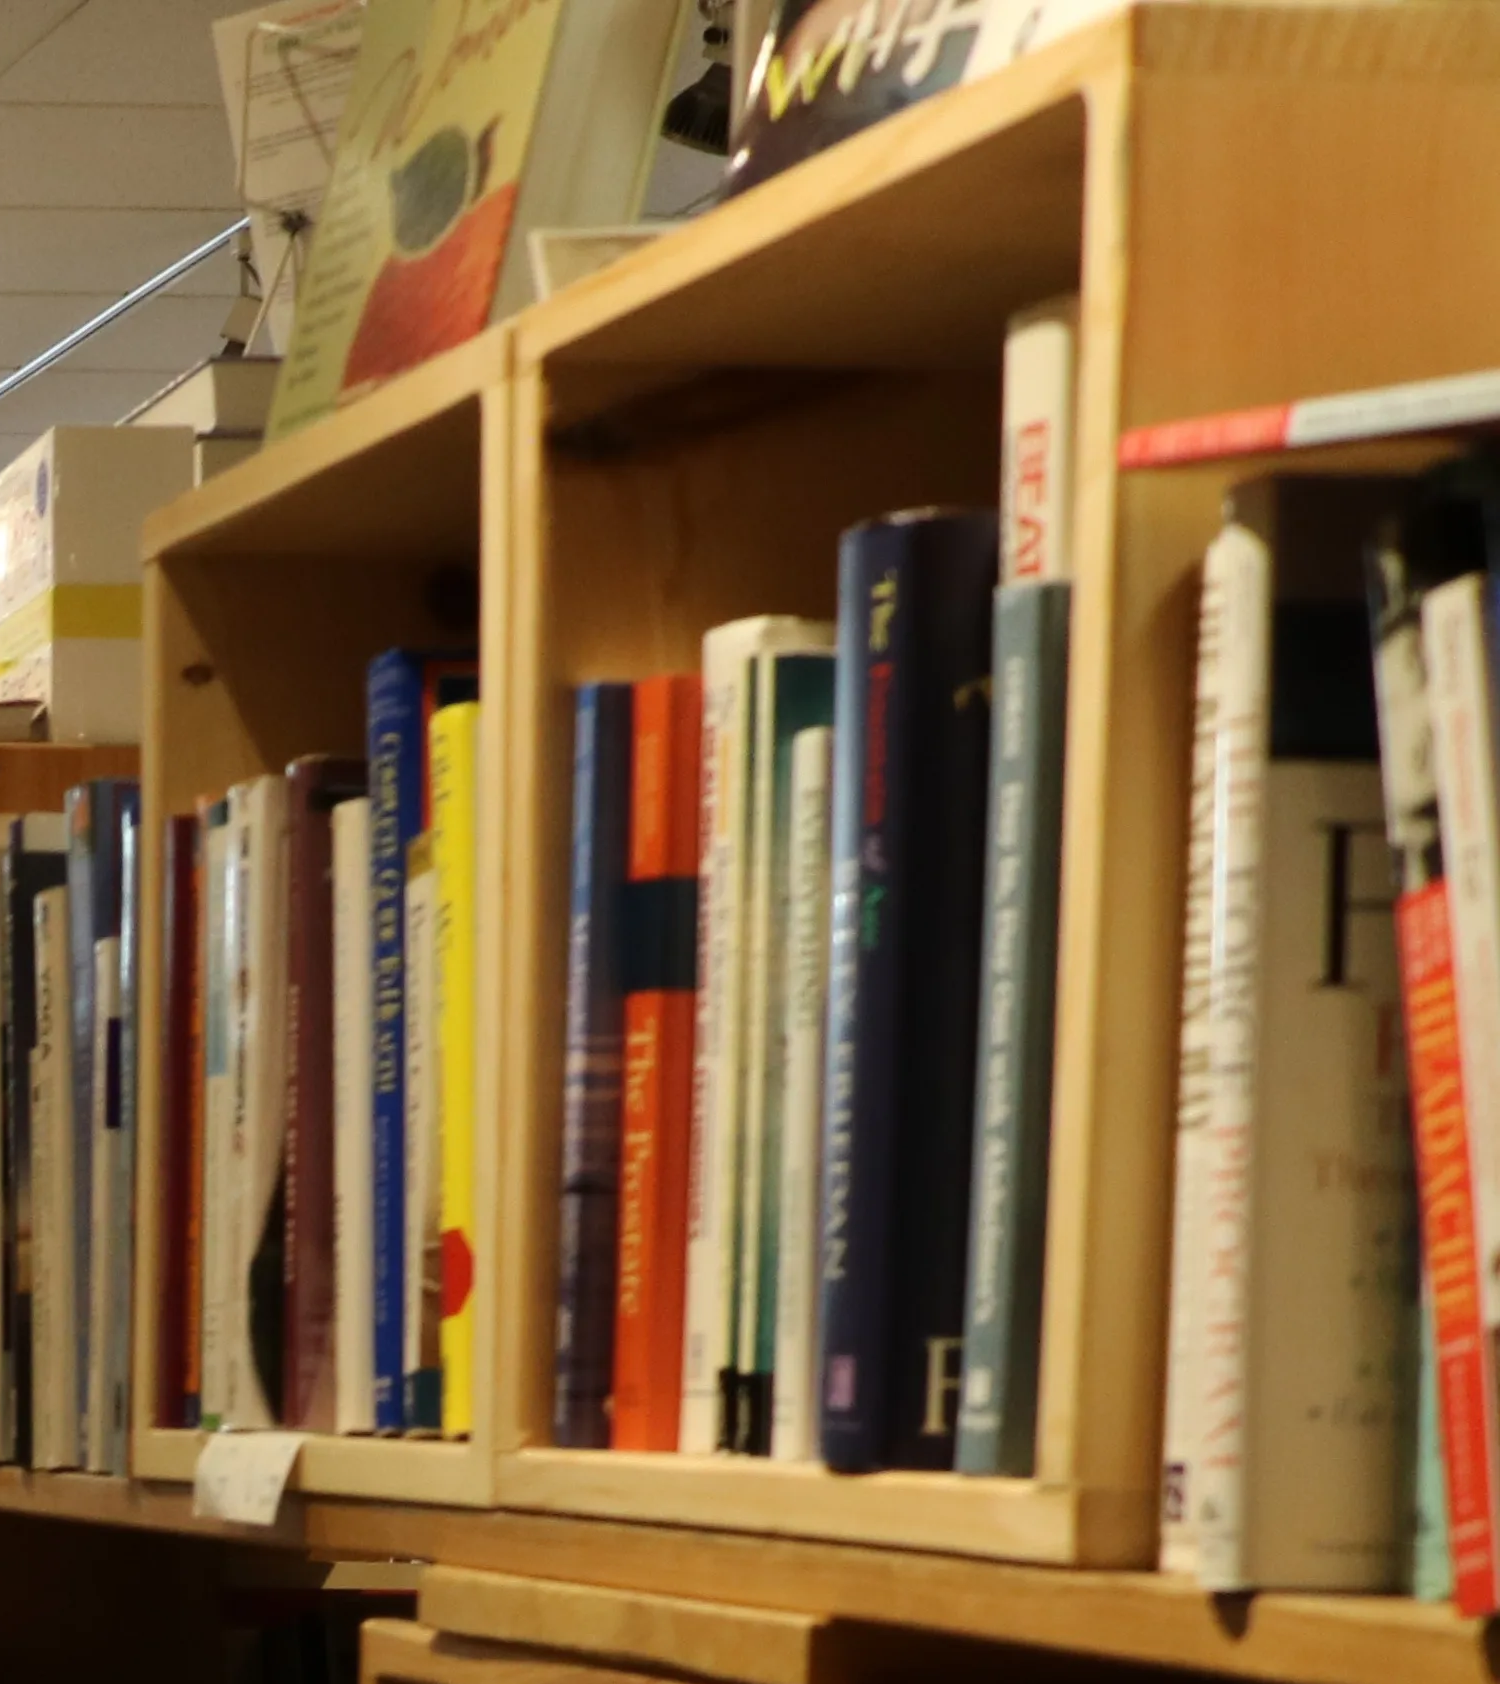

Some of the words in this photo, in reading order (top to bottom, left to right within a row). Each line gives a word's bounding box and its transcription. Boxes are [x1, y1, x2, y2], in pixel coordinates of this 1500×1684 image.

[628, 1019, 656, 1115] The
[826, 1036, 855, 1279] FRIEDAN
[1409, 976, 1475, 1320] HEADACHE
[622, 1130, 656, 1317] Prostate
